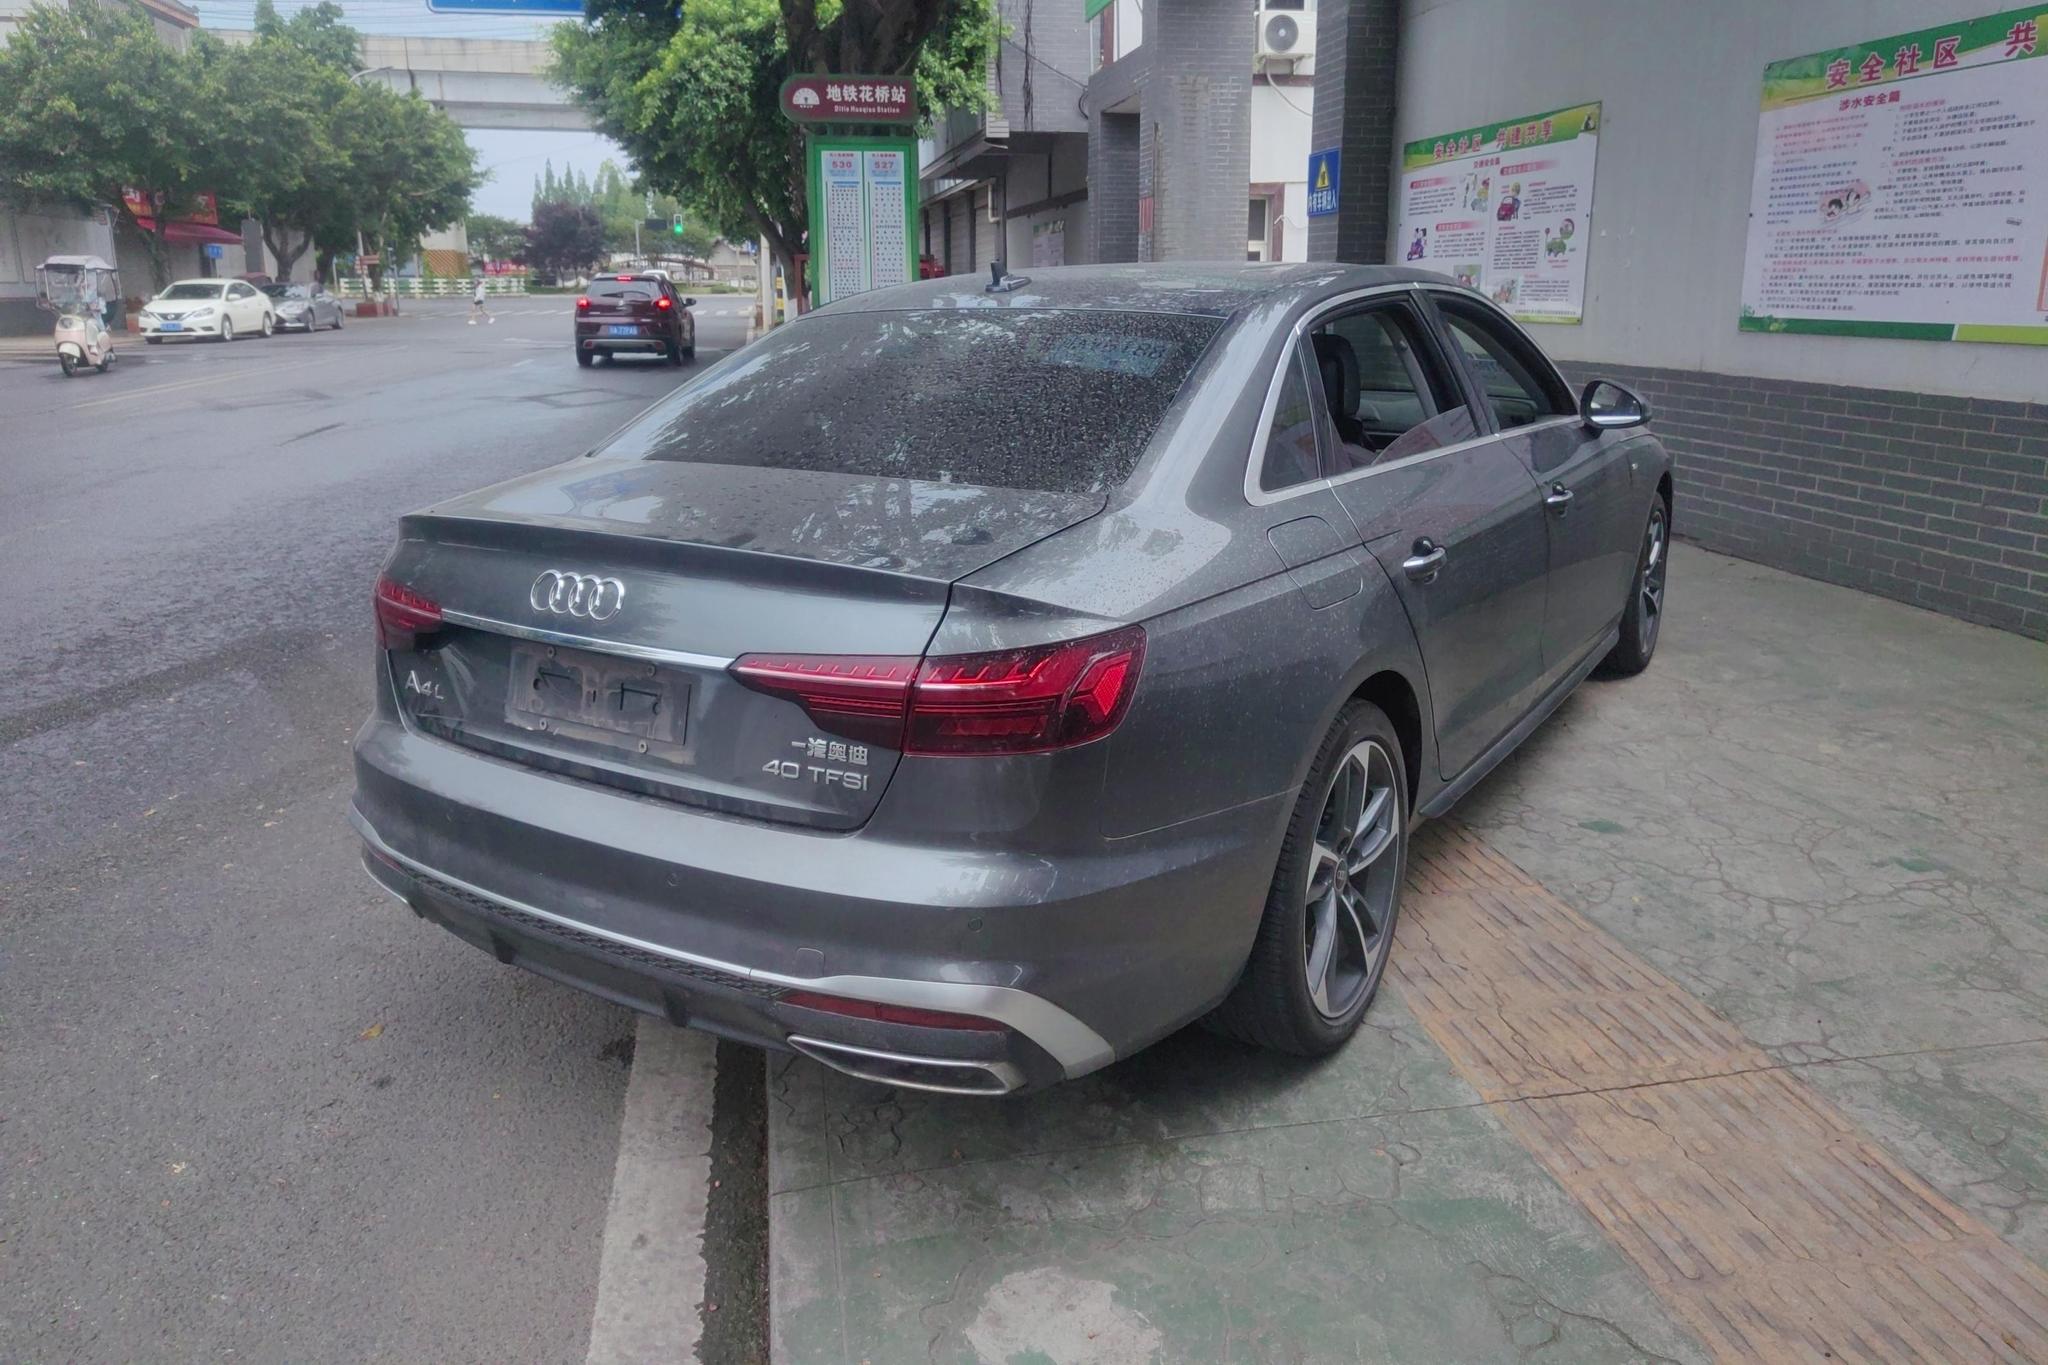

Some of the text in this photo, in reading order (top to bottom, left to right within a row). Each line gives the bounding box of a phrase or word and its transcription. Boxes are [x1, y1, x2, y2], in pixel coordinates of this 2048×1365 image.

[1826, 20, 2038, 90] 安全社区 共
[826, 84, 907, 104] 地铁花桥站
[877, 105, 900, 114] Station
[1433, 120, 1553, 160] 安全社区 共建共享
[874, 160, 895, 169] 527
[405, 670, 444, 700] A4L
[791, 737, 868, 766] 一汽奥迪
[762, 759, 869, 791] 40 TFSI
